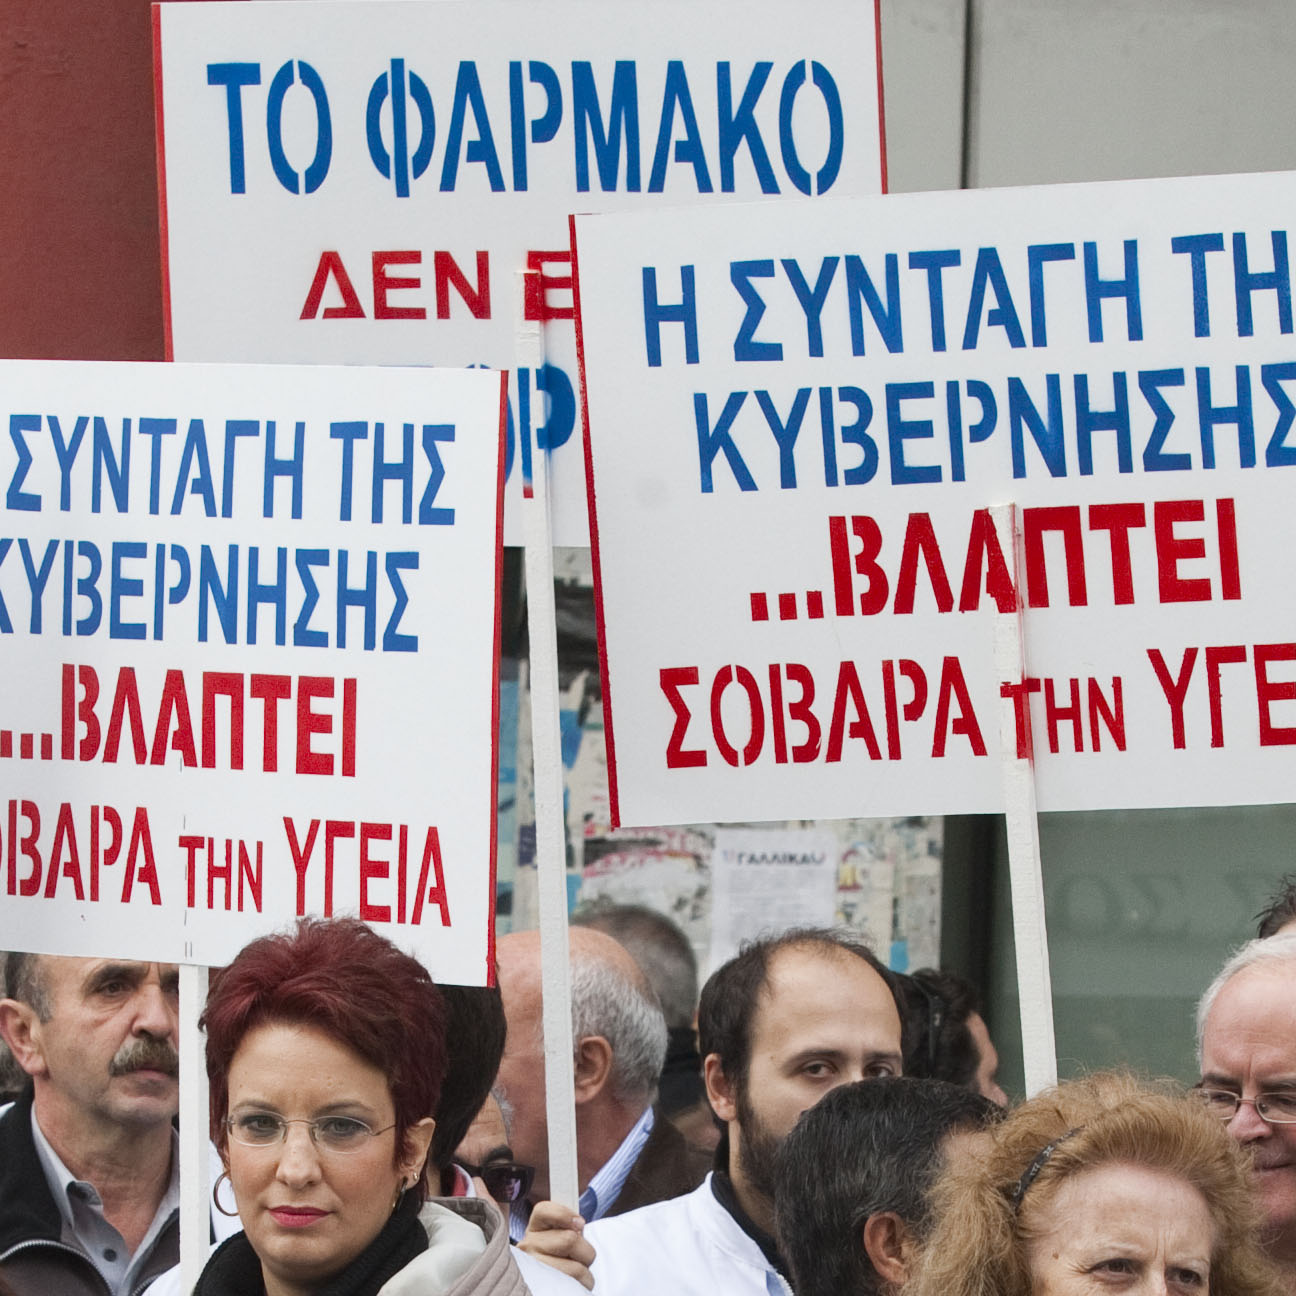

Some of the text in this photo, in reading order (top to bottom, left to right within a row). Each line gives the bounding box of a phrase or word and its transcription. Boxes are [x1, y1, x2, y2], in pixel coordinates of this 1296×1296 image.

[206, 57, 844, 198] ΤΟ ΦΑΡΜΑΚΟ
[300, 251, 491, 320] ΔΕΝ
[642, 264, 700, 367] Η
[730, 239, 1144, 361] ΣΥΝΤΑΓΗ
[6, 414, 305, 520] ΣΥΝΤΑΓΗ
[329, 421, 456, 525] ΤΗΣ
[660, 656, 987, 768] ΣΟΒΑΡΑ
[1000, 672, 1126, 763] ΤΗΝ
[179, 836, 263, 912] ΤΗΝ
[283, 816, 451, 926] ΥΓΕΙΑ
